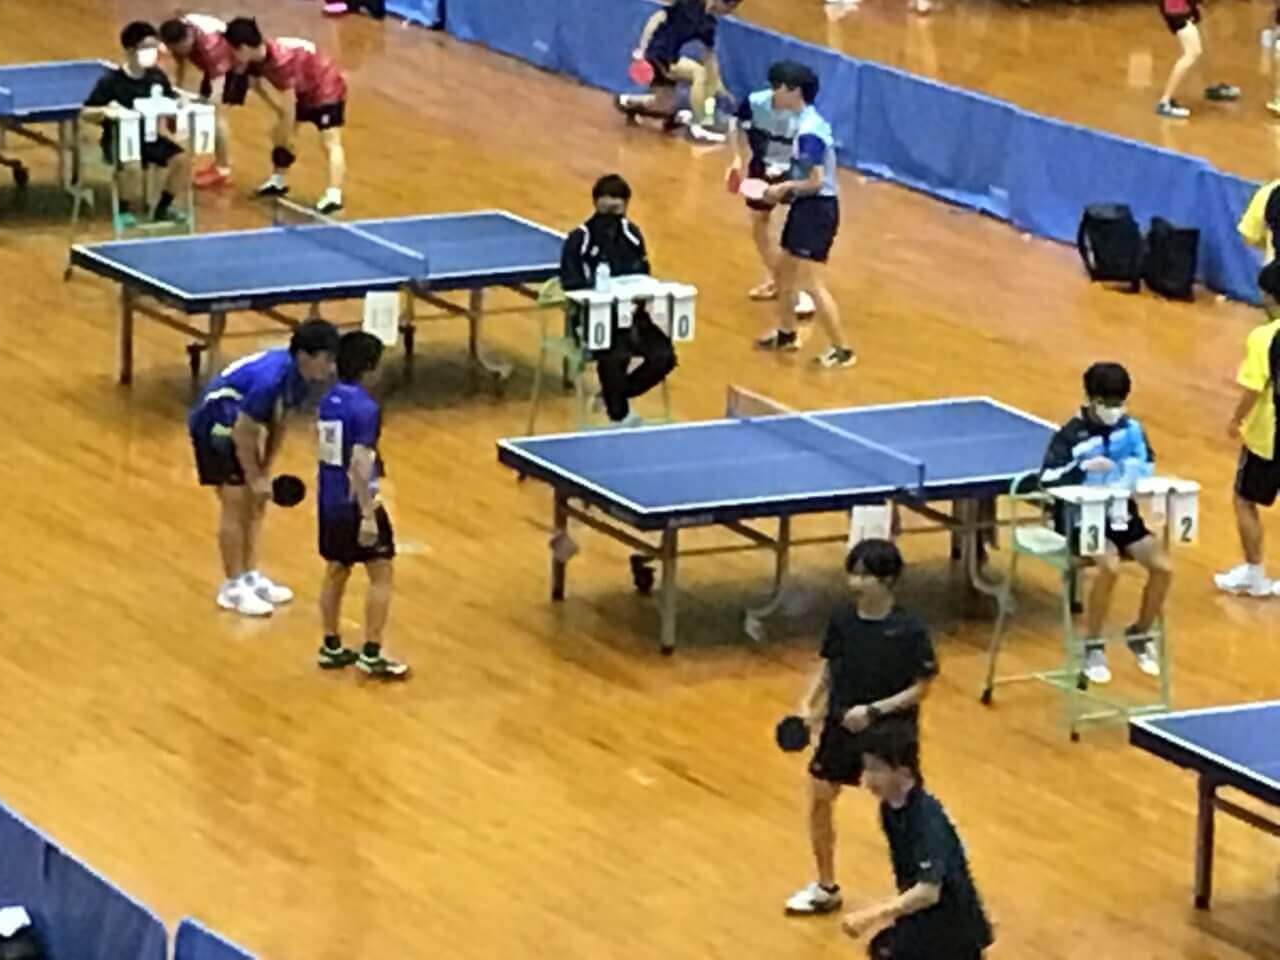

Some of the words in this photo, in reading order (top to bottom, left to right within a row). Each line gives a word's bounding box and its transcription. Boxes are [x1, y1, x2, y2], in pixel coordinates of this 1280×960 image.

[593, 321, 606, 347] 0
[678, 314, 690, 339] 0
[1086, 524, 1100, 553] 3
[1180, 516, 1194, 544] 2
